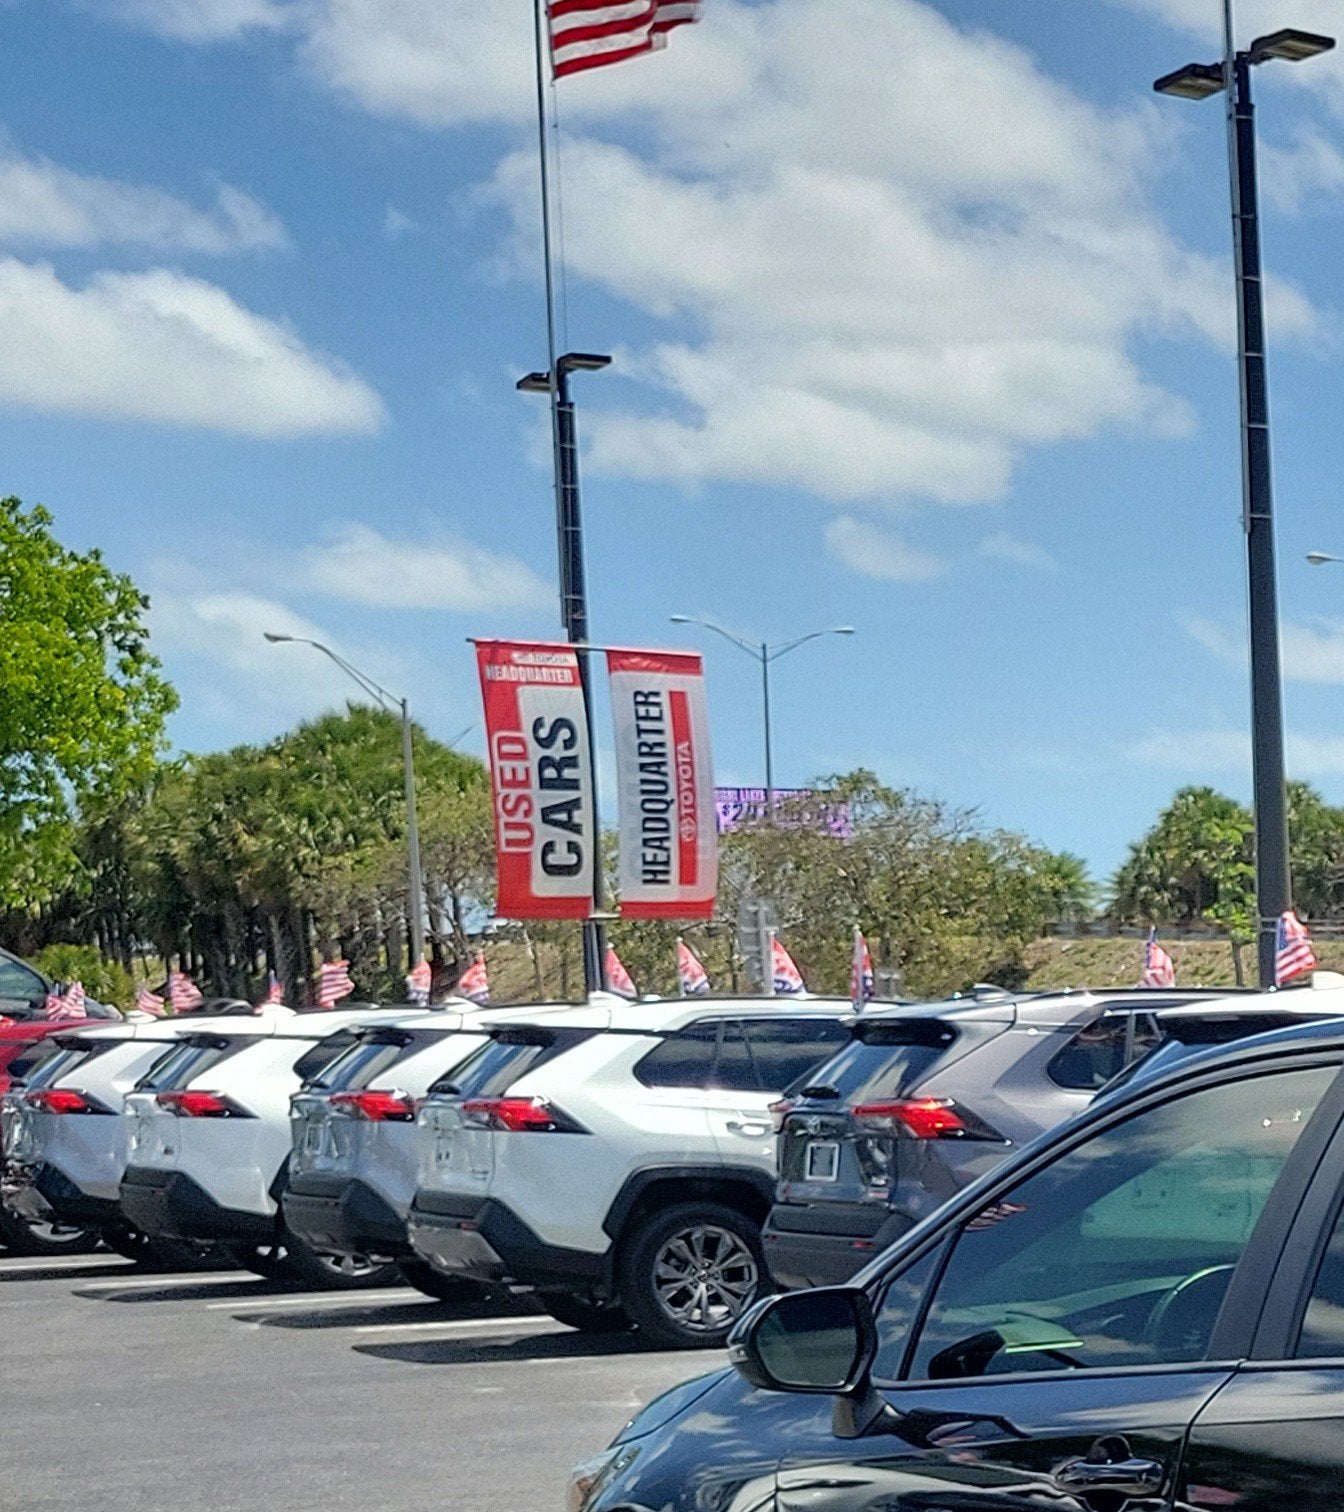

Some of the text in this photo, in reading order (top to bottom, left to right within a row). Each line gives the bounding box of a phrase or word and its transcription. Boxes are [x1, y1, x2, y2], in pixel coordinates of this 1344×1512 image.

[486, 664, 574, 685] HEADQUARTER
[493, 729, 535, 854] USED
[532, 716, 584, 878] CARS
[633, 689, 674, 886] HEADQUARTER
[676, 741, 698, 823] TOYOTA
